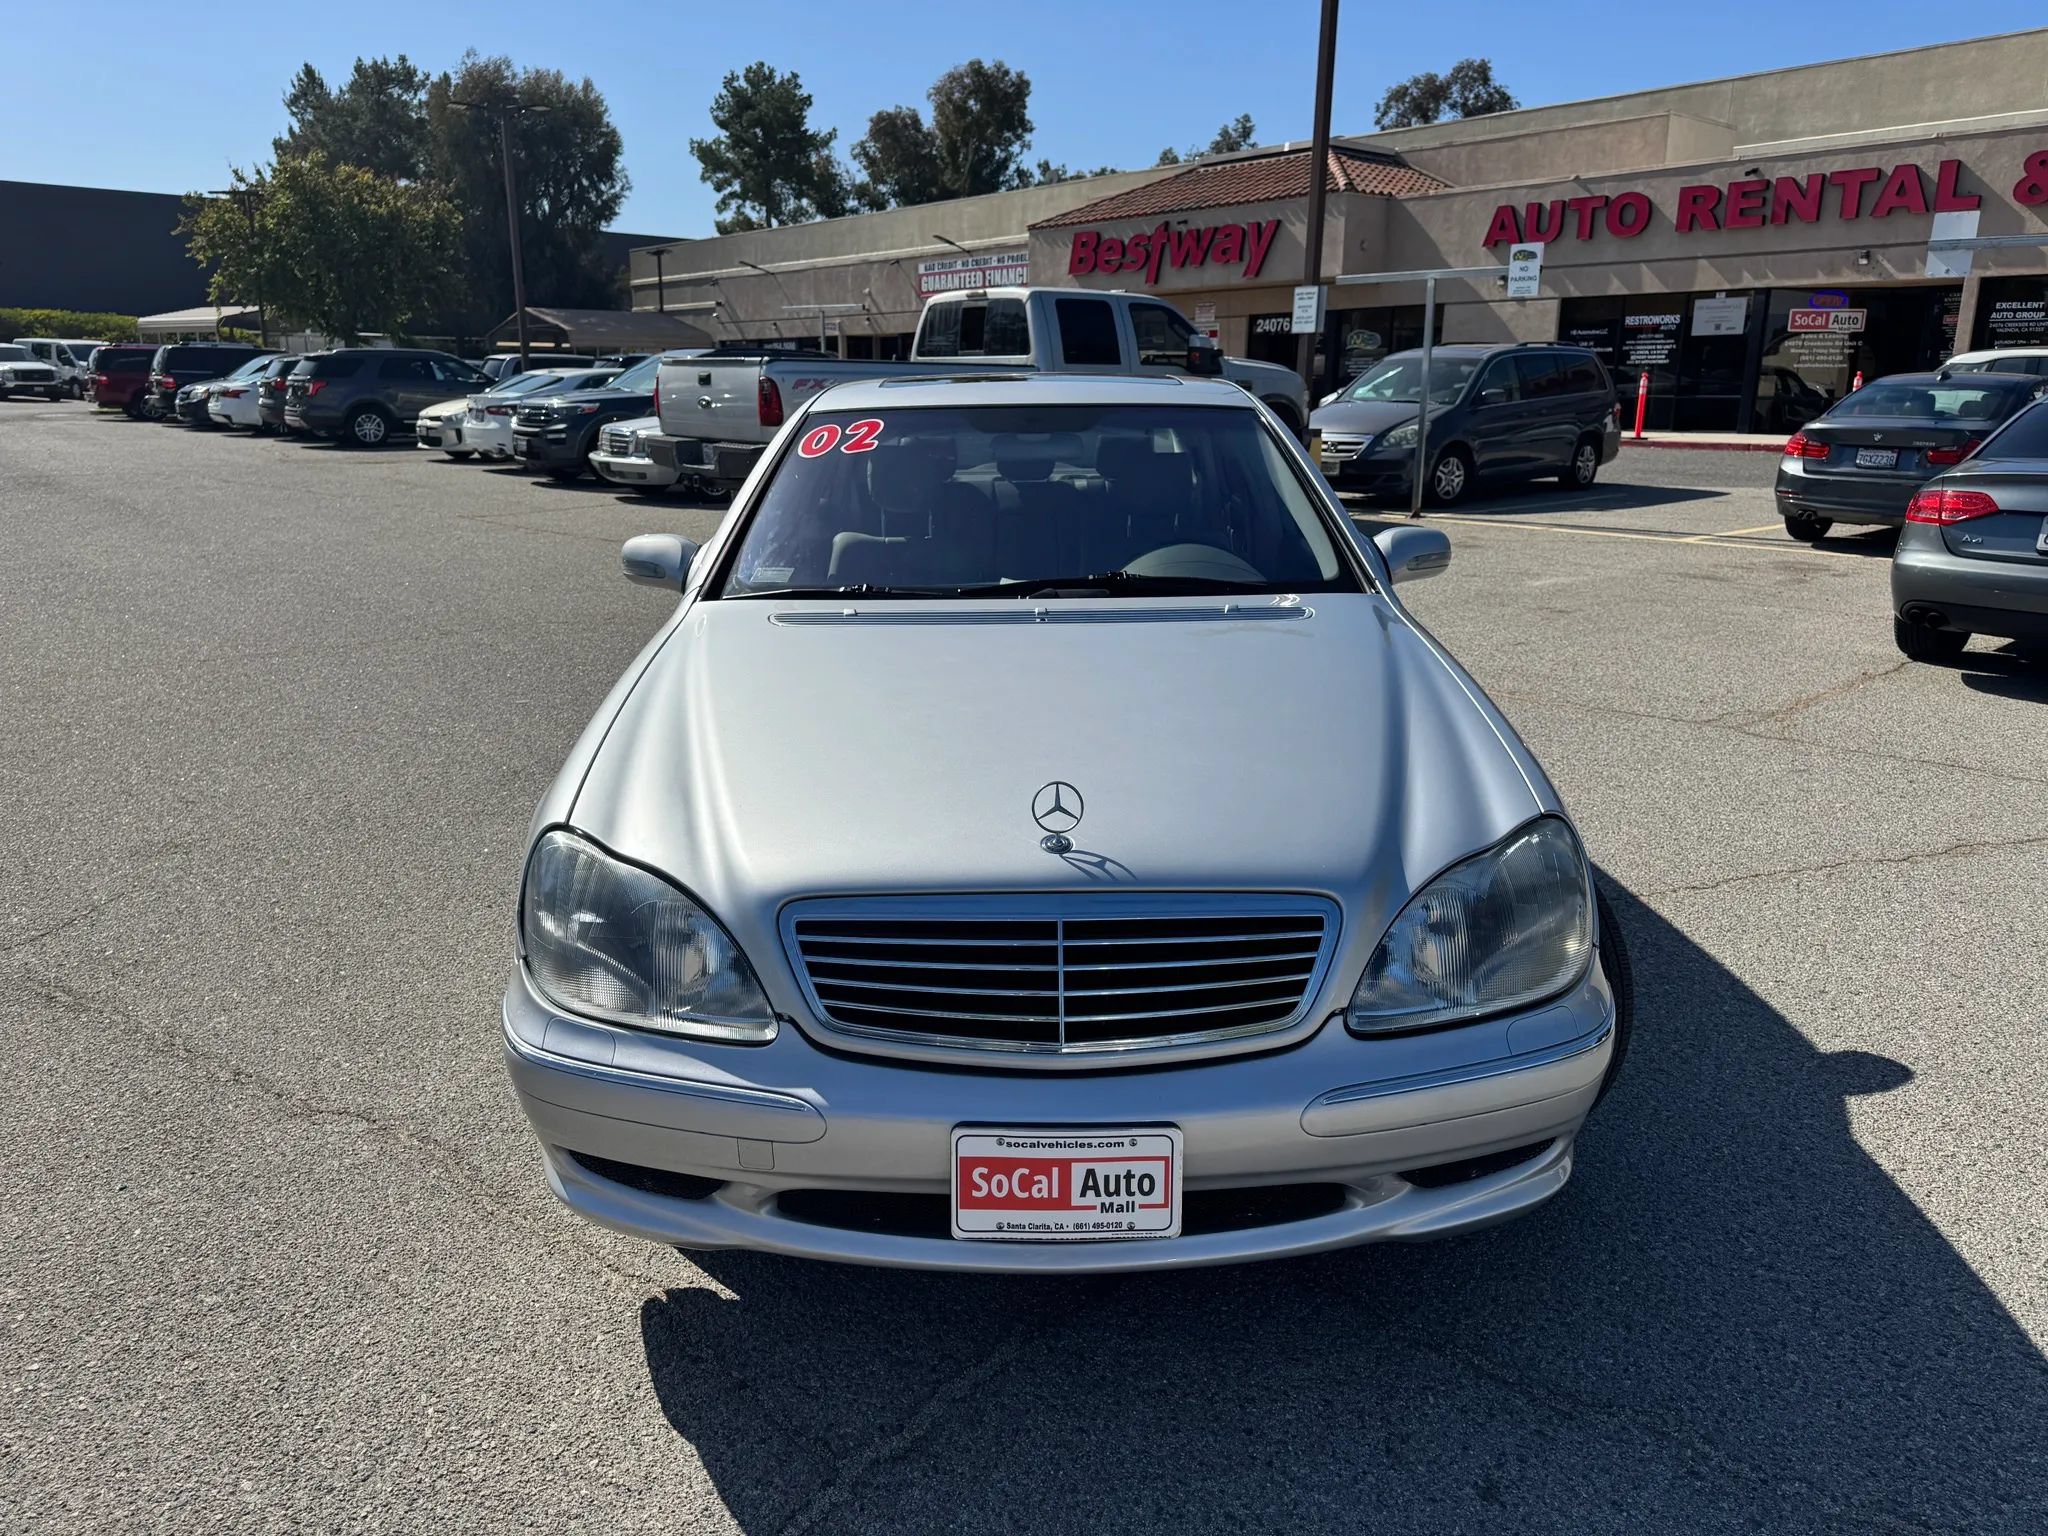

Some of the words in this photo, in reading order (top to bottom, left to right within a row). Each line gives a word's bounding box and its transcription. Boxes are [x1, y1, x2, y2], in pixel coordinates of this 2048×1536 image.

[1482, 191, 1653, 249] AUTO
[1675, 158, 1982, 234] RENTAL
[1068, 220, 1282, 286] Bestway
[921, 270, 983, 292] GUARANTEED
[1995, 301, 2045, 309] EXCELLENT
[1624, 314, 1681, 326] RESTROWORKS
[1794, 313, 1826, 326] SoCal
[1831, 314, 1859, 326] Auto
[1990, 311, 2014, 319] AUTO
[2015, 311, 2046, 319] GROUP
[1256, 317, 1291, 333] 24076
[798, 418, 884, 459] 02
[1005, 1139, 1125, 1150] socalvehicles.com
[971, 1165, 1060, 1199] SoCal
[1078, 1167, 1157, 1198] Auto
[1099, 1200, 1136, 1214] Mall
[1005, 1221, 1027, 1230] Santa
[1027, 1221, 1053, 1231] Clarita,
[1053, 1221, 1065, 1231] CA
[1072, 1221, 1091, 1231] (661)
[1091, 1220, 1123, 1230] 495-0120
